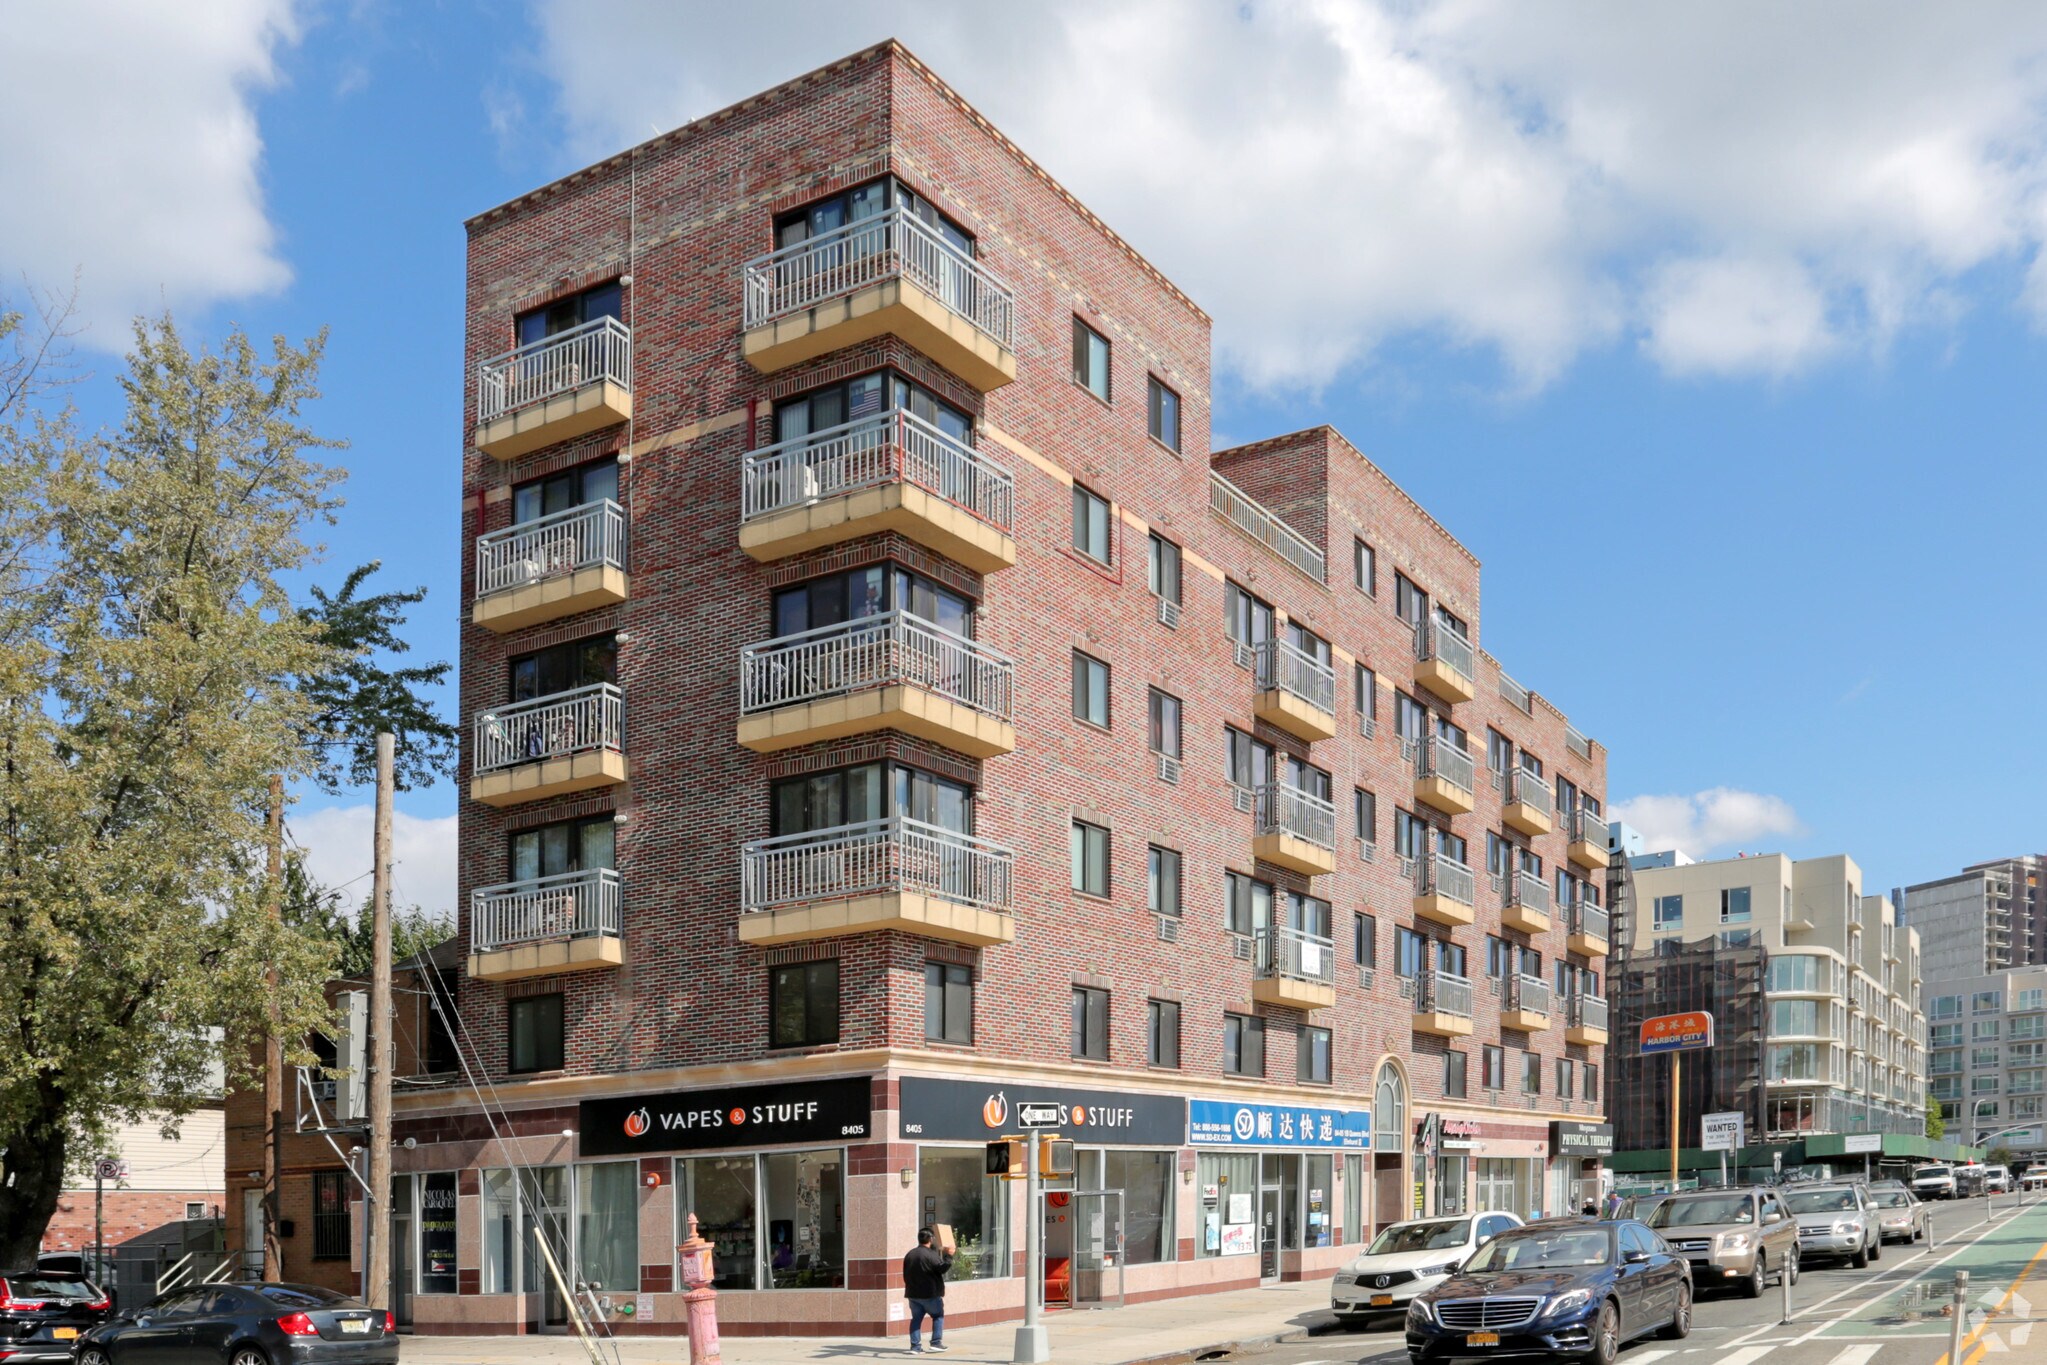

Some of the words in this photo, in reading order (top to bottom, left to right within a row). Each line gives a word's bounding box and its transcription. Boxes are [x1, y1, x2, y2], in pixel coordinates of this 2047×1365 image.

[1647, 1034, 1681, 1045] HARBOR
[1682, 1033, 1701, 1041] CITY
[660, 1109, 723, 1130] VAPES
[752, 1102, 818, 1124] STUFF
[1025, 1111, 1036, 1120] ONE
[1041, 1111, 1055, 1120] WAY
[1088, 1106, 1133, 1127] STUFF
[841, 1125, 864, 1135] 8405
[905, 1124, 922, 1133] 8405
[1257, 1111, 1333, 1141] 顺达快递
[1706, 1122, 1738, 1133] WANTED
[1562, 1134, 1589, 1146] PHYSICAL
[1590, 1135, 1613, 1147] THERAPY
[423, 1189, 455, 1200] NICOLAS
